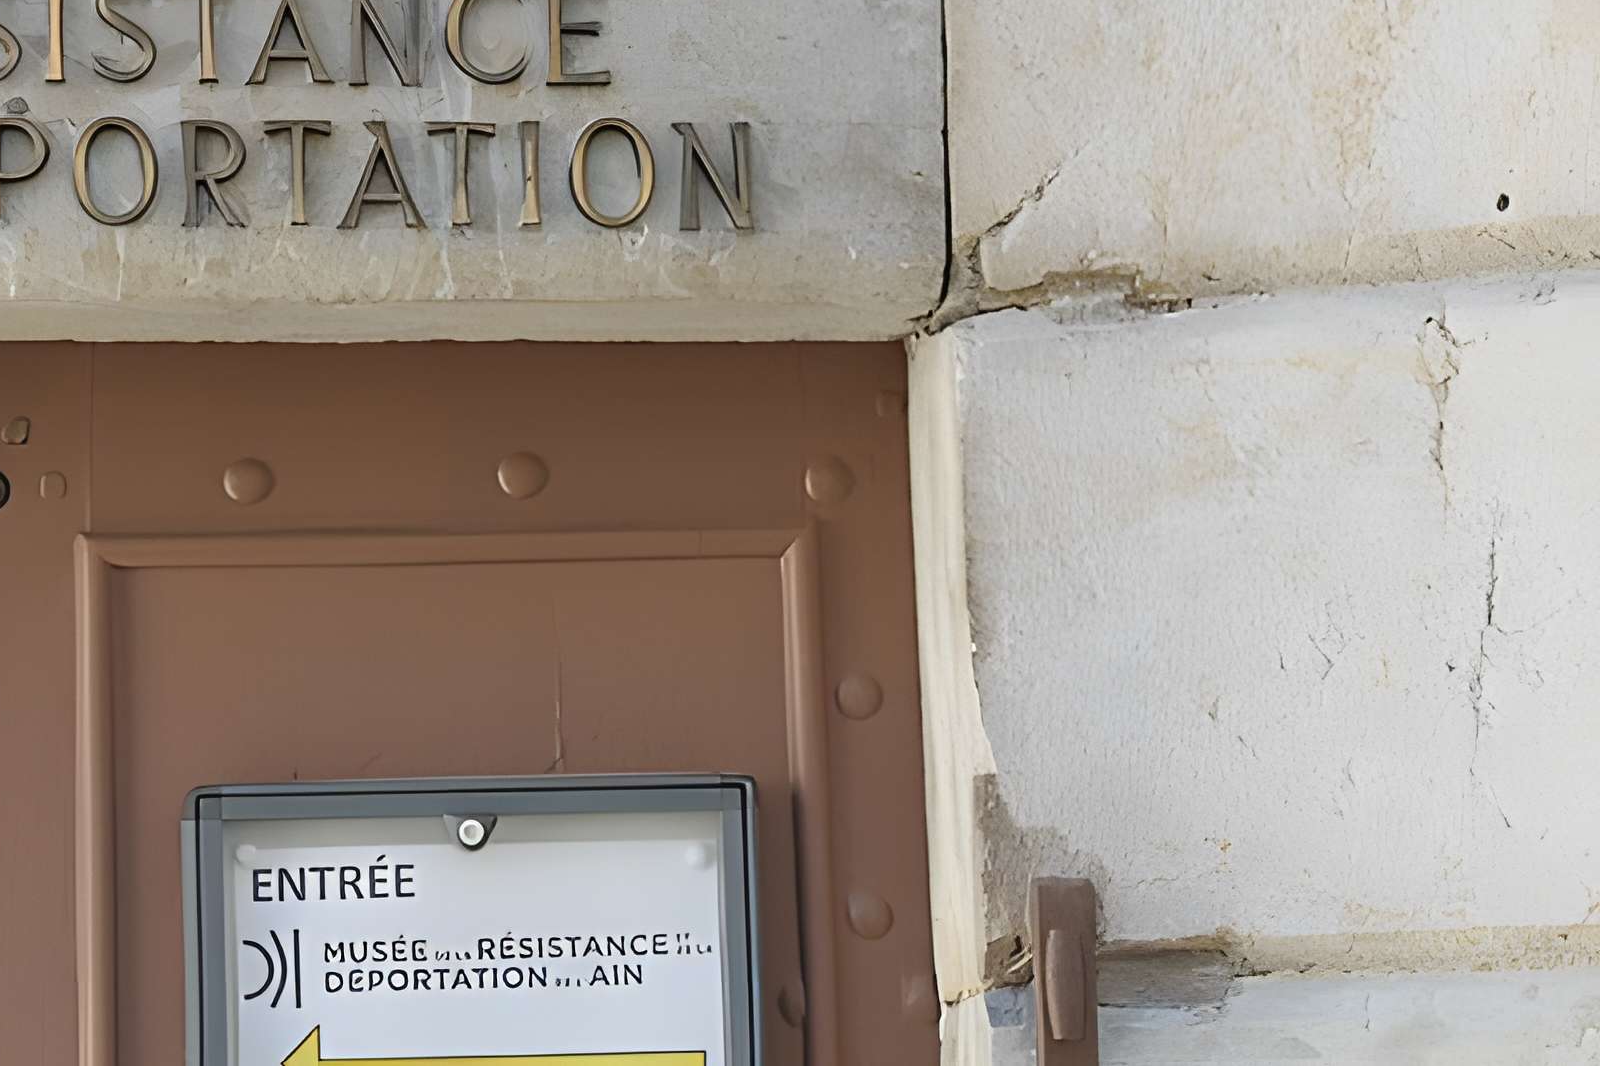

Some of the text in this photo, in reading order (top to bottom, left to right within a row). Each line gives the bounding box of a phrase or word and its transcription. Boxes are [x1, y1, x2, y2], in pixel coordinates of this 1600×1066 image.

[252, 854, 415, 902] ENTRÉE
[324, 934, 428, 963] MUSÉE
[477, 931, 669, 960] RÉSISTANCE
[588, 964, 643, 986] AIN
